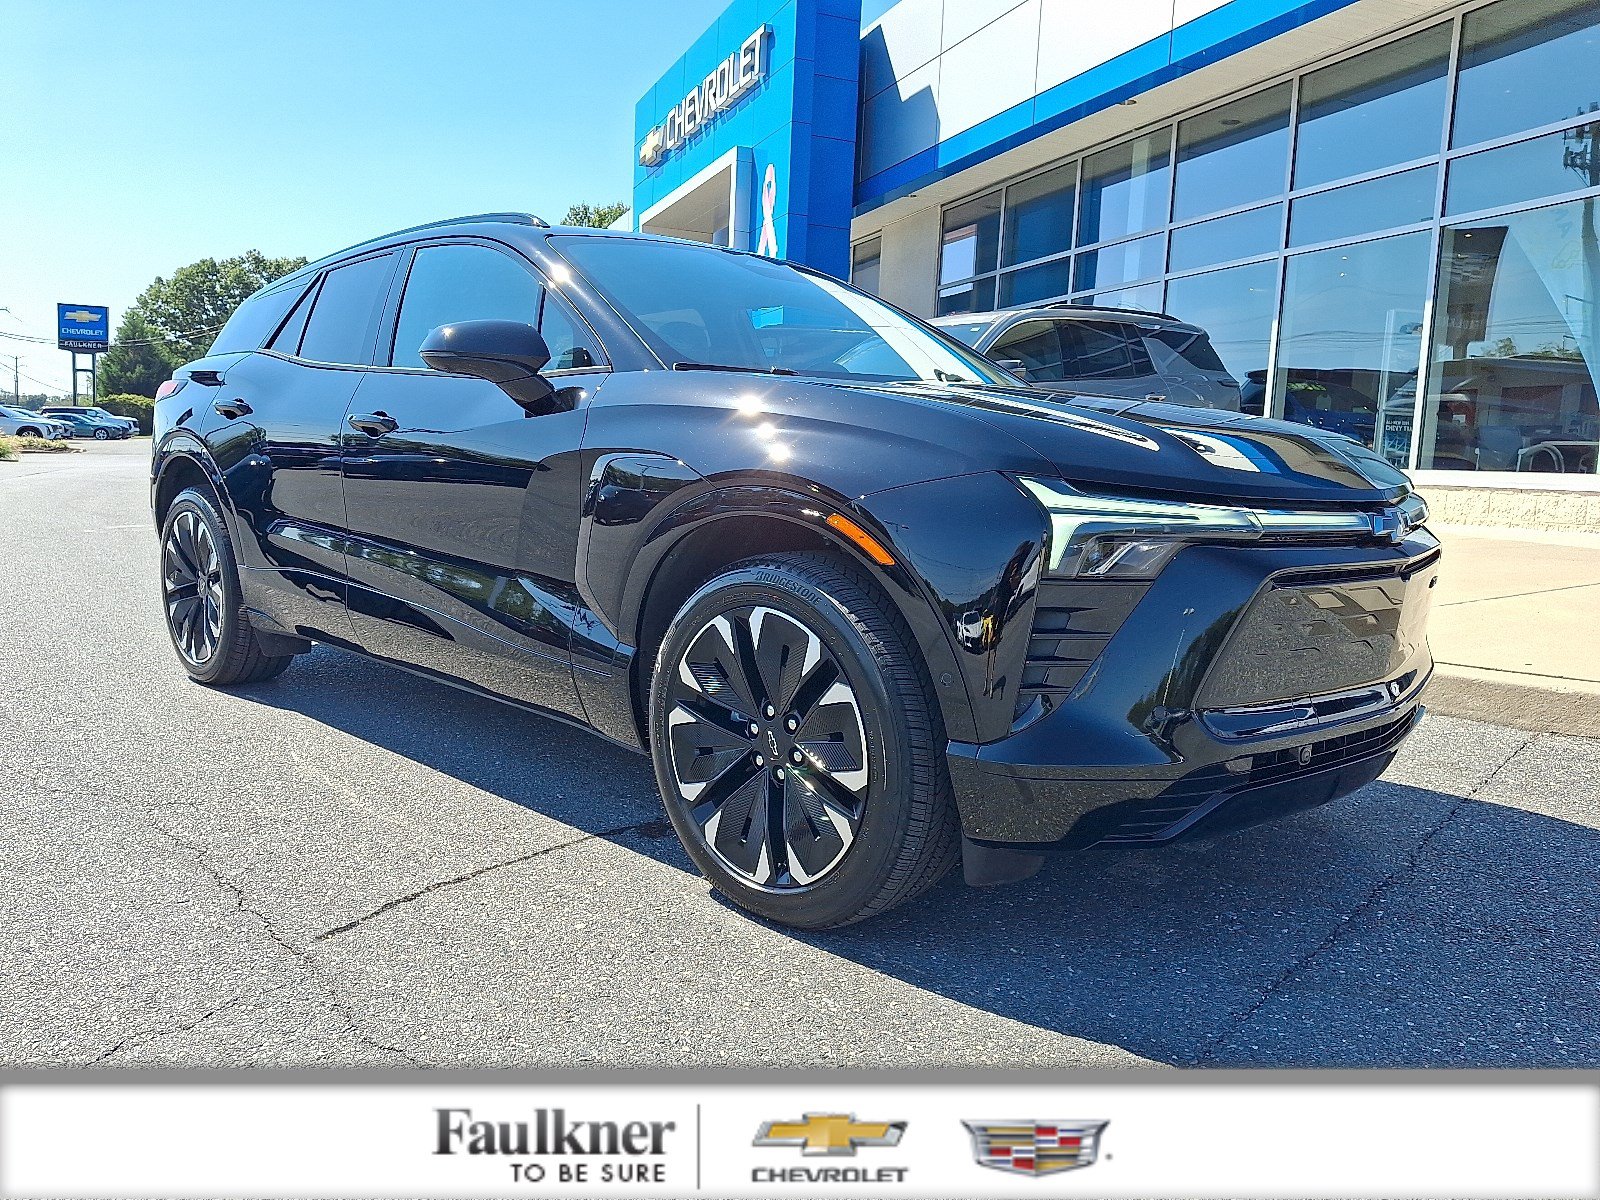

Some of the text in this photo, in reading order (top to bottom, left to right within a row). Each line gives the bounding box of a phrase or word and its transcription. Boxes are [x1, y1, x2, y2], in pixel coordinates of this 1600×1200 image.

[666, 23, 768, 149] CHEVROLET
[61, 327, 104, 336] CHEVROLET
[64, 340, 102, 349] FAULKNER
[755, 570, 822, 606] BRIDGESTONE
